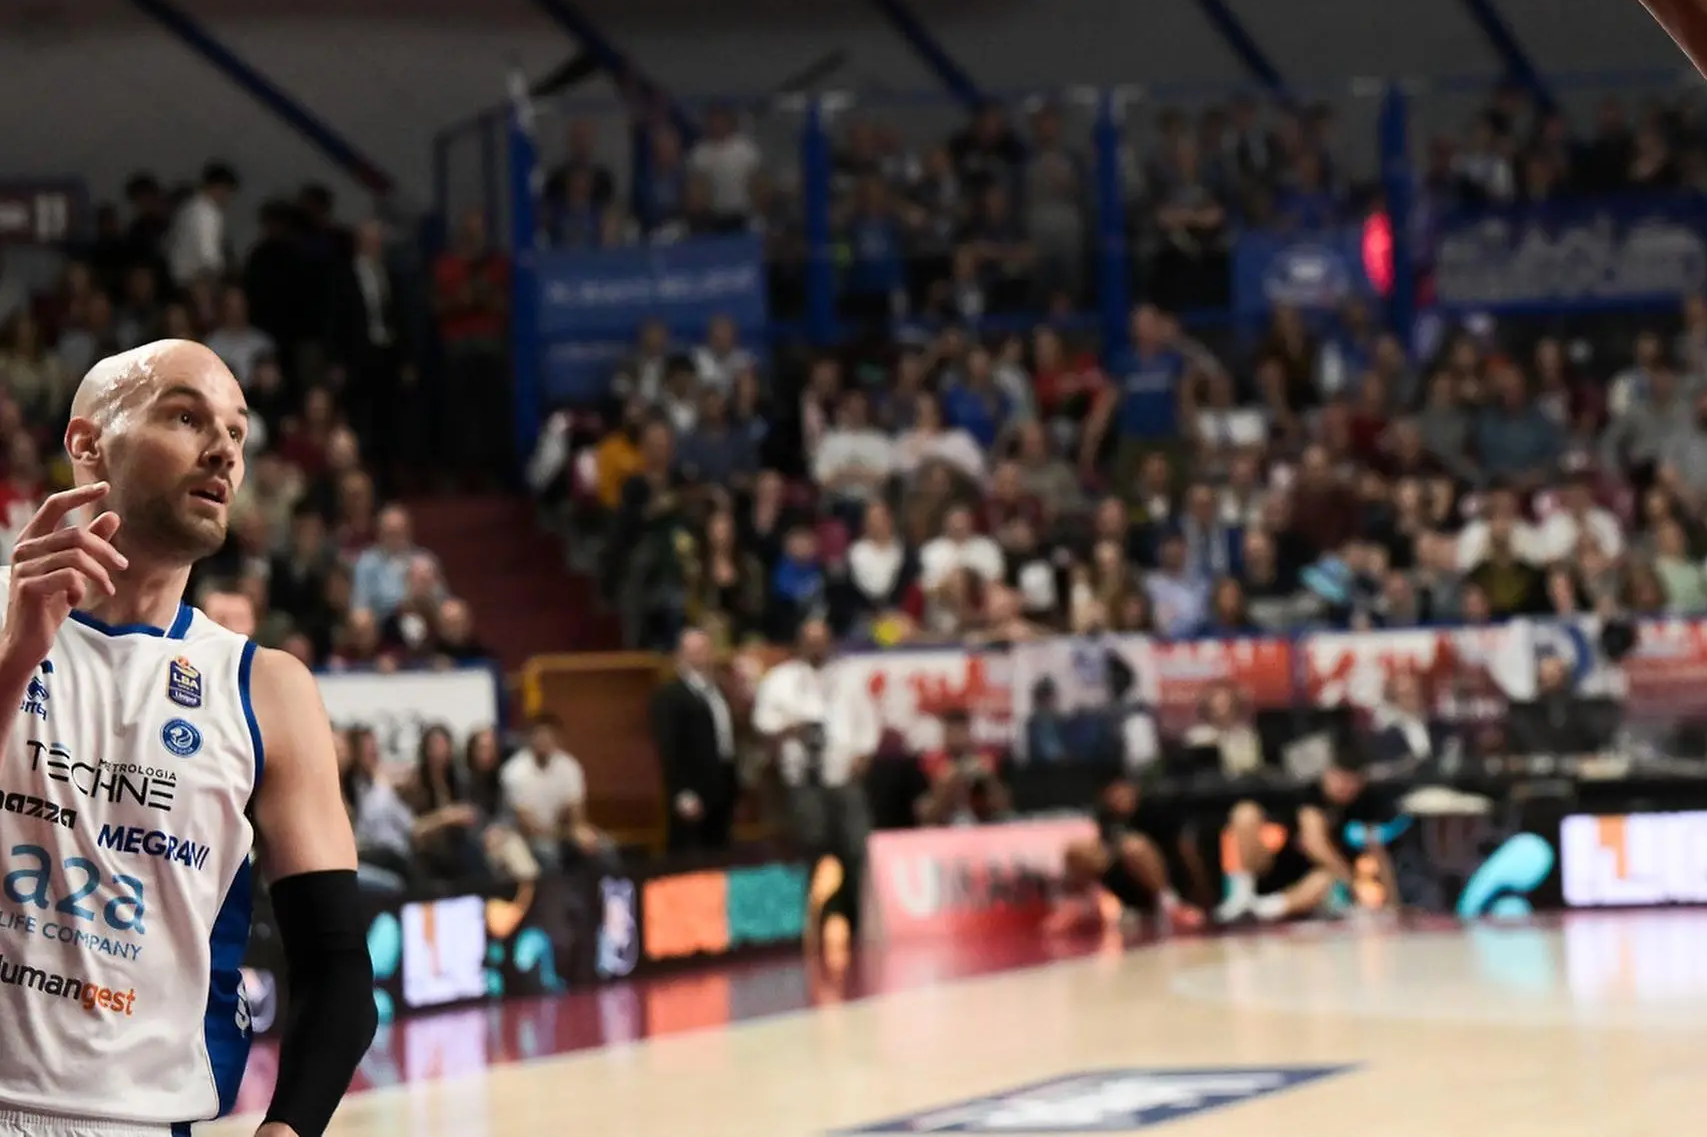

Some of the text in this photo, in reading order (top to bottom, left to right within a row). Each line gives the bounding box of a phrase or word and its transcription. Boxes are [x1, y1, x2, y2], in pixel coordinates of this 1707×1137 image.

[27, 740, 176, 811] TECHNE
[3, 844, 146, 935] a2a
[42, 922, 142, 962] COMPANY
[0, 954, 136, 1016] umangest
